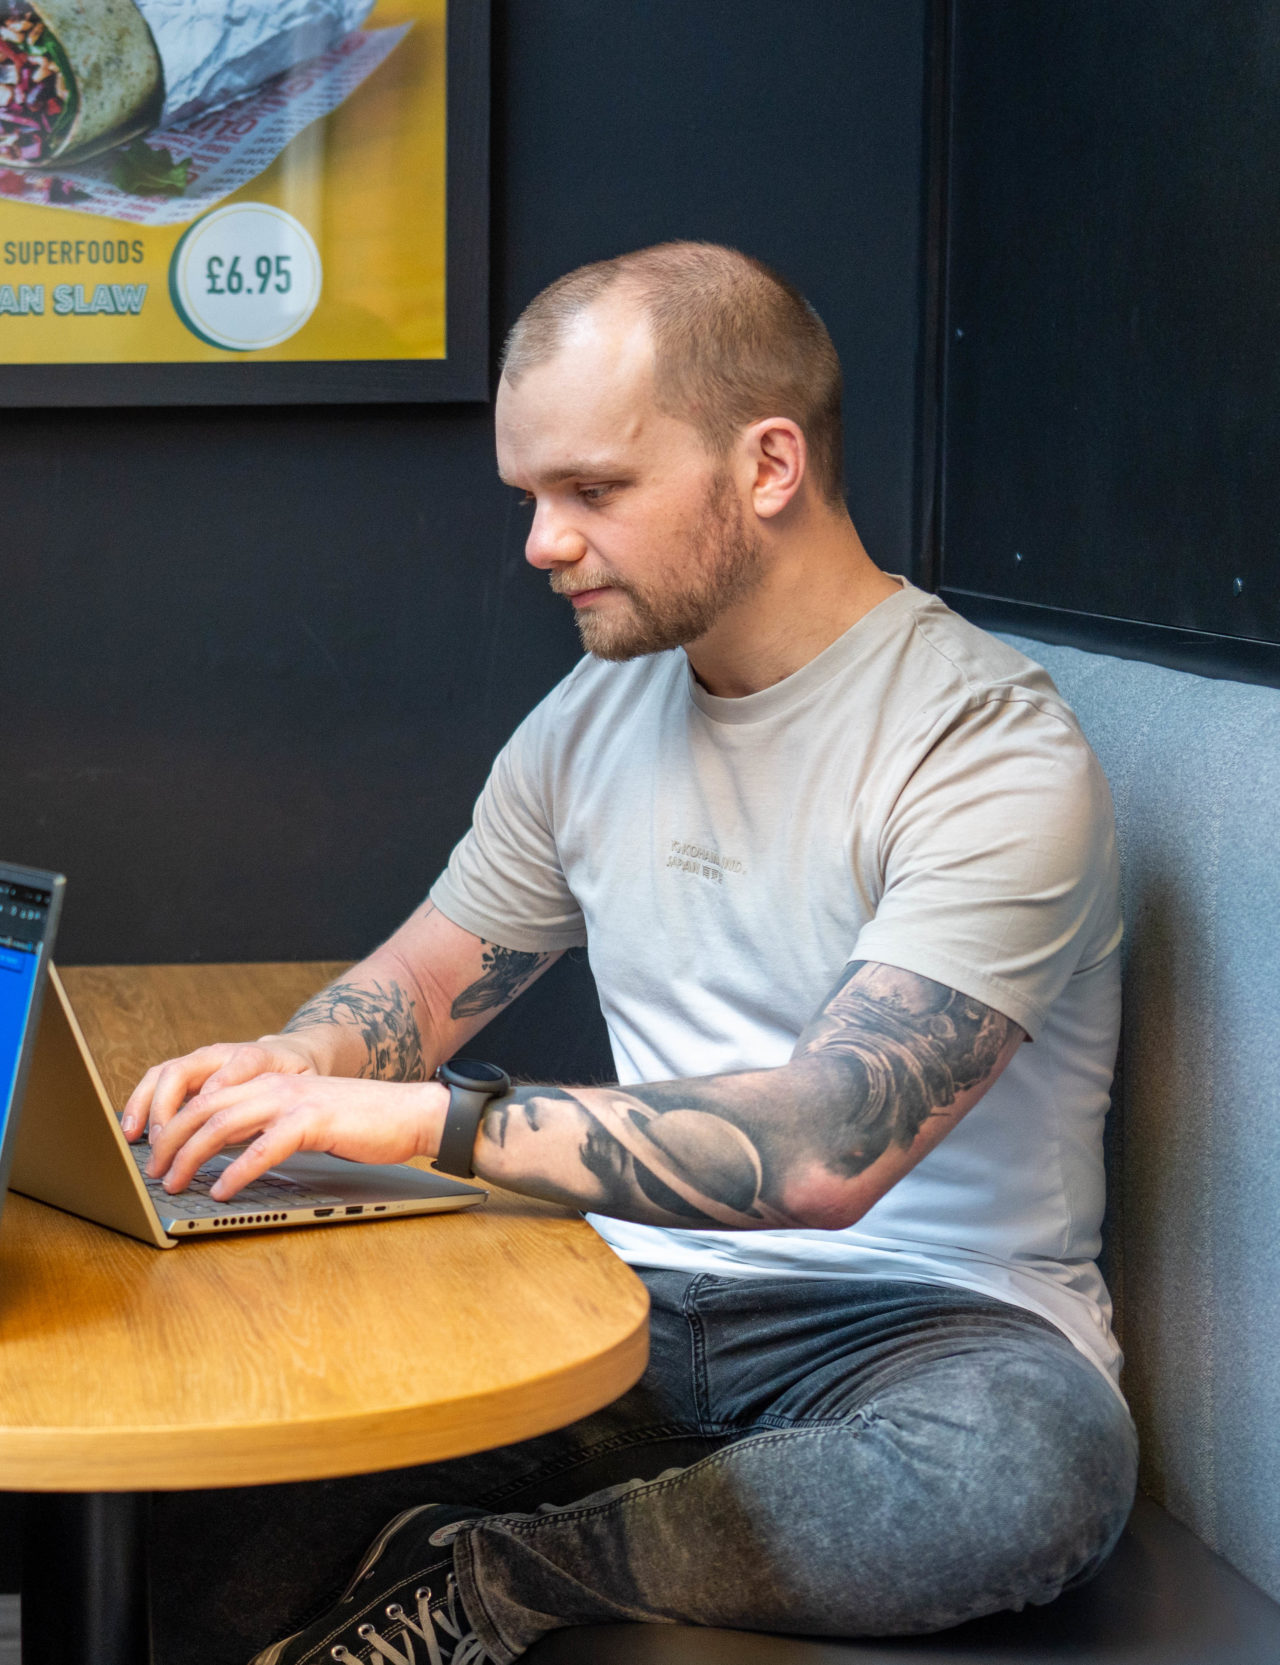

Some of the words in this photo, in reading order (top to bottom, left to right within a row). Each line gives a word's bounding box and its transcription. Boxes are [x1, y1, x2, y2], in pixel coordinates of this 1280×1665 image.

[4, 240, 145, 265] SUPERFOODS
[206, 255, 292, 295] £6.95
[53, 283, 148, 316] SLAW
